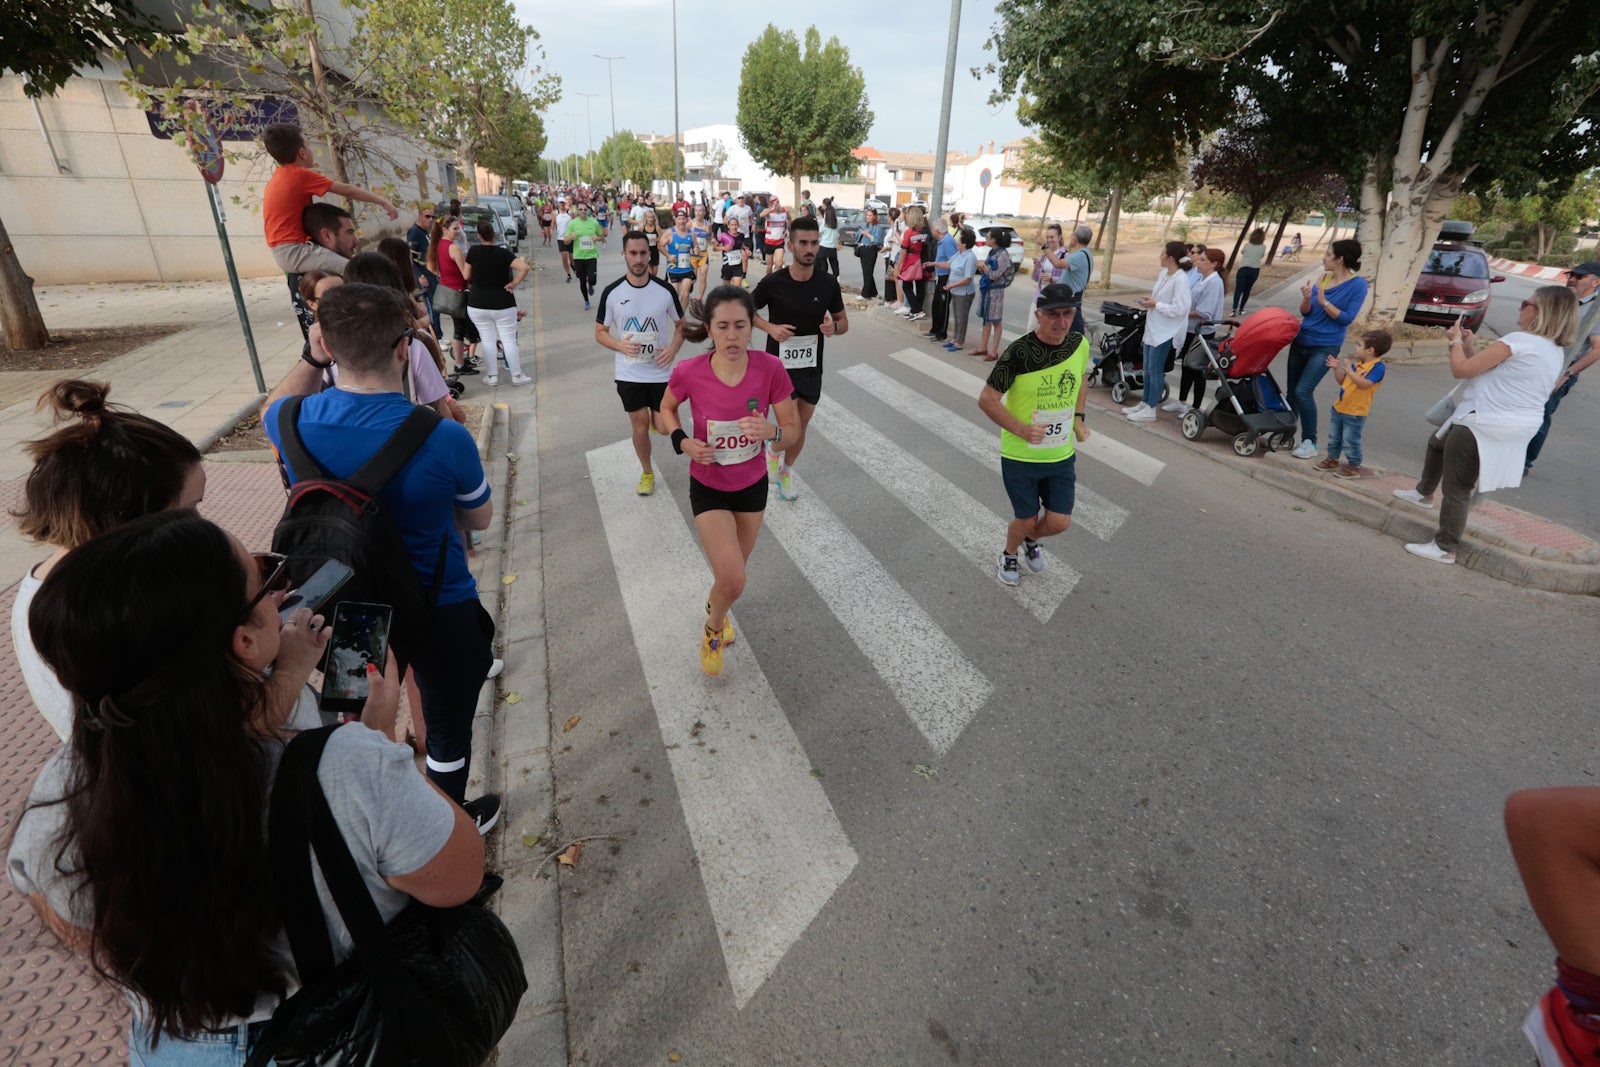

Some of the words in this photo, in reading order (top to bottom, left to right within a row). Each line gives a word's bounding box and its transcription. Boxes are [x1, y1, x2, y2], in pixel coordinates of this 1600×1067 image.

[784, 347, 813, 360] 3078
[1041, 375, 1053, 386] XI
[1046, 423, 1062, 436] 35
